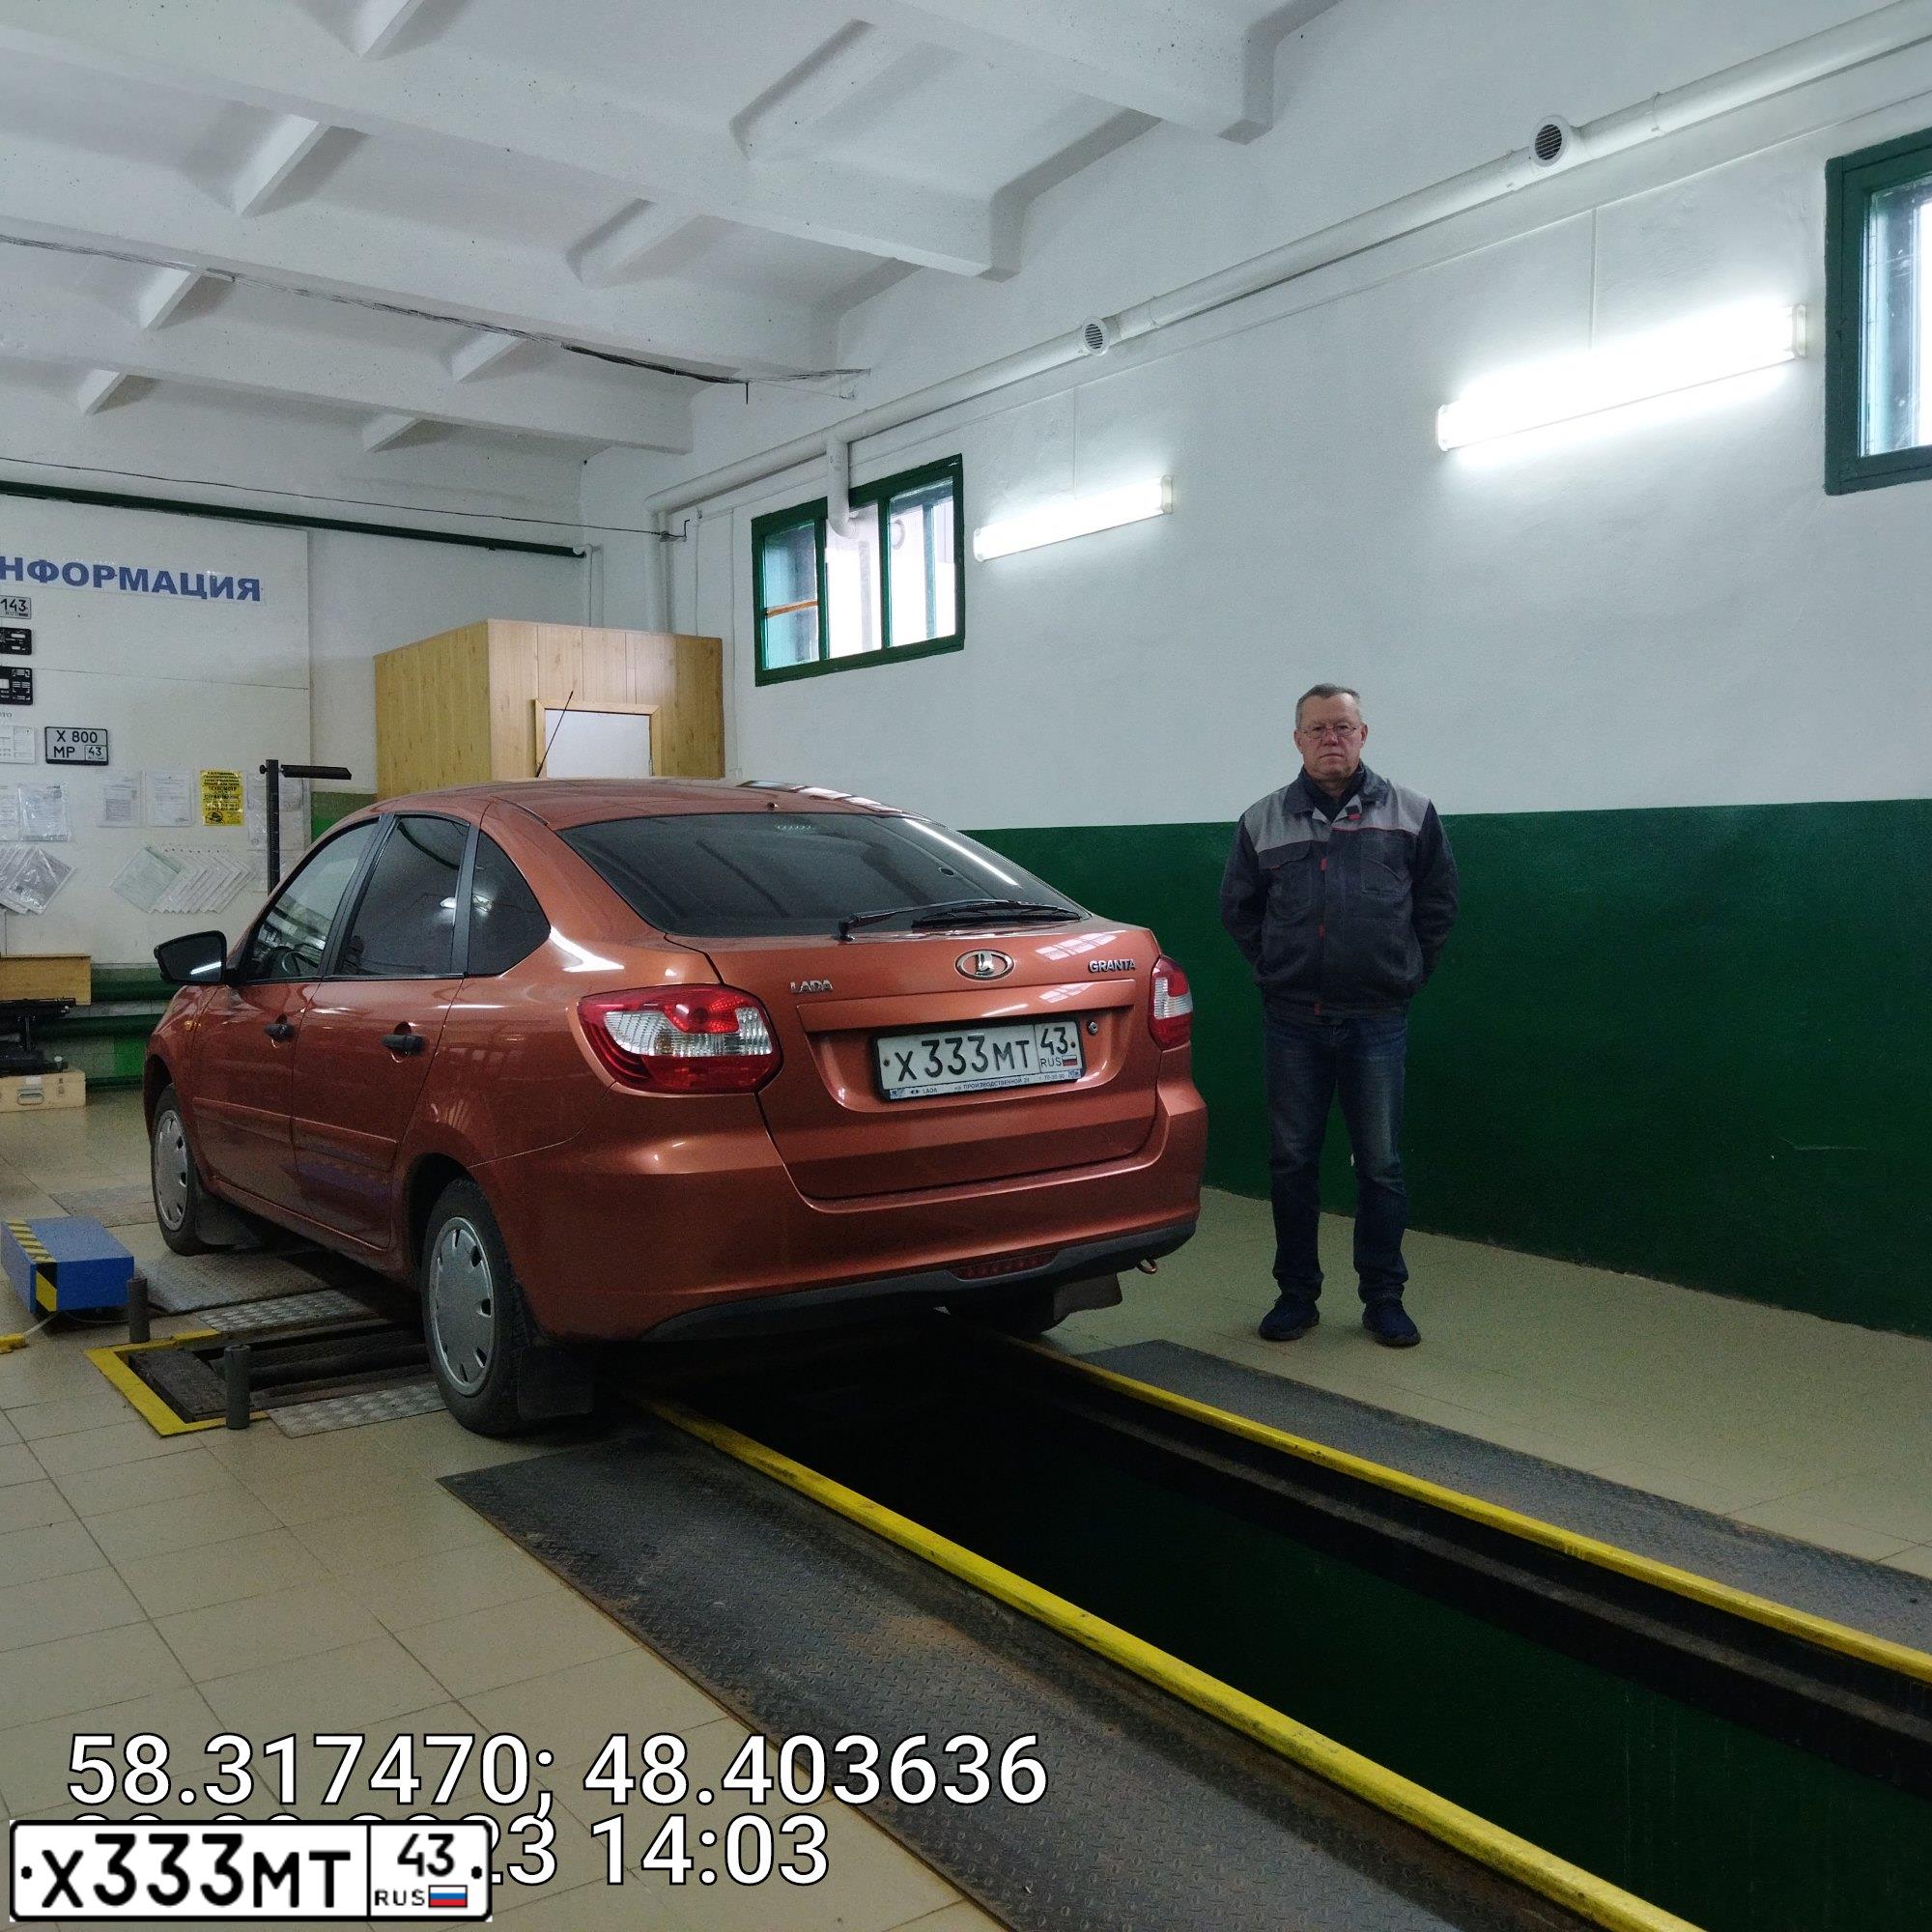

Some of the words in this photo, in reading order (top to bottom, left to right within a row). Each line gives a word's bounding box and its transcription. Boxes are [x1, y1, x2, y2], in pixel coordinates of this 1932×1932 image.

[71, 730, 99, 744] 800
[53, 746, 75, 759] МР
[88, 747, 102, 756] 43
[1087, 959, 1136, 974] GRANTA
[790, 979, 834, 995] LADA
[894, 1033, 1031, 1082] Х333МТ
[1039, 1026, 1069, 1056] 43
[1039, 1056, 1063, 1068] RUS
